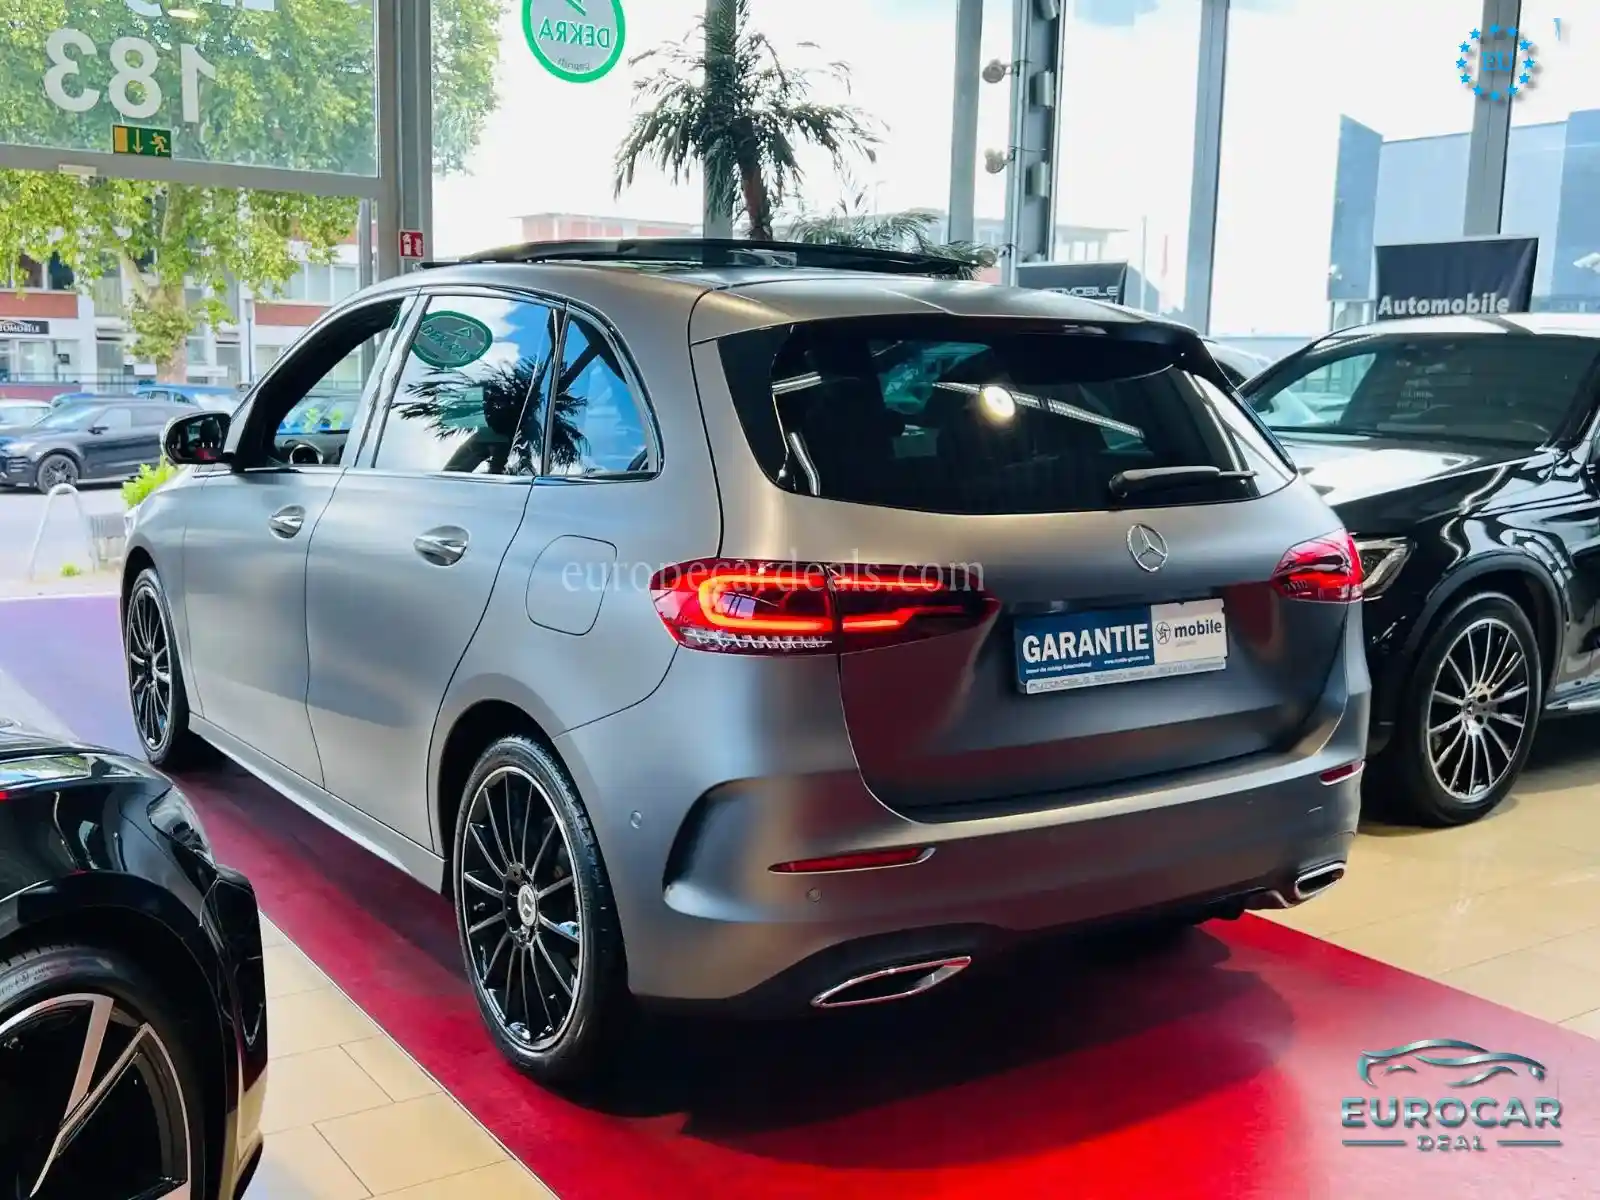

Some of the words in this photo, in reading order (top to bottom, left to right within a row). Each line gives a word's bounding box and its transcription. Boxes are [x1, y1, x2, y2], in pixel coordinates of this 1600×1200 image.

[1378, 291, 1511, 316] Automobile
[1174, 619, 1222, 638] mobile
[1022, 623, 1150, 664] GARANTIE
